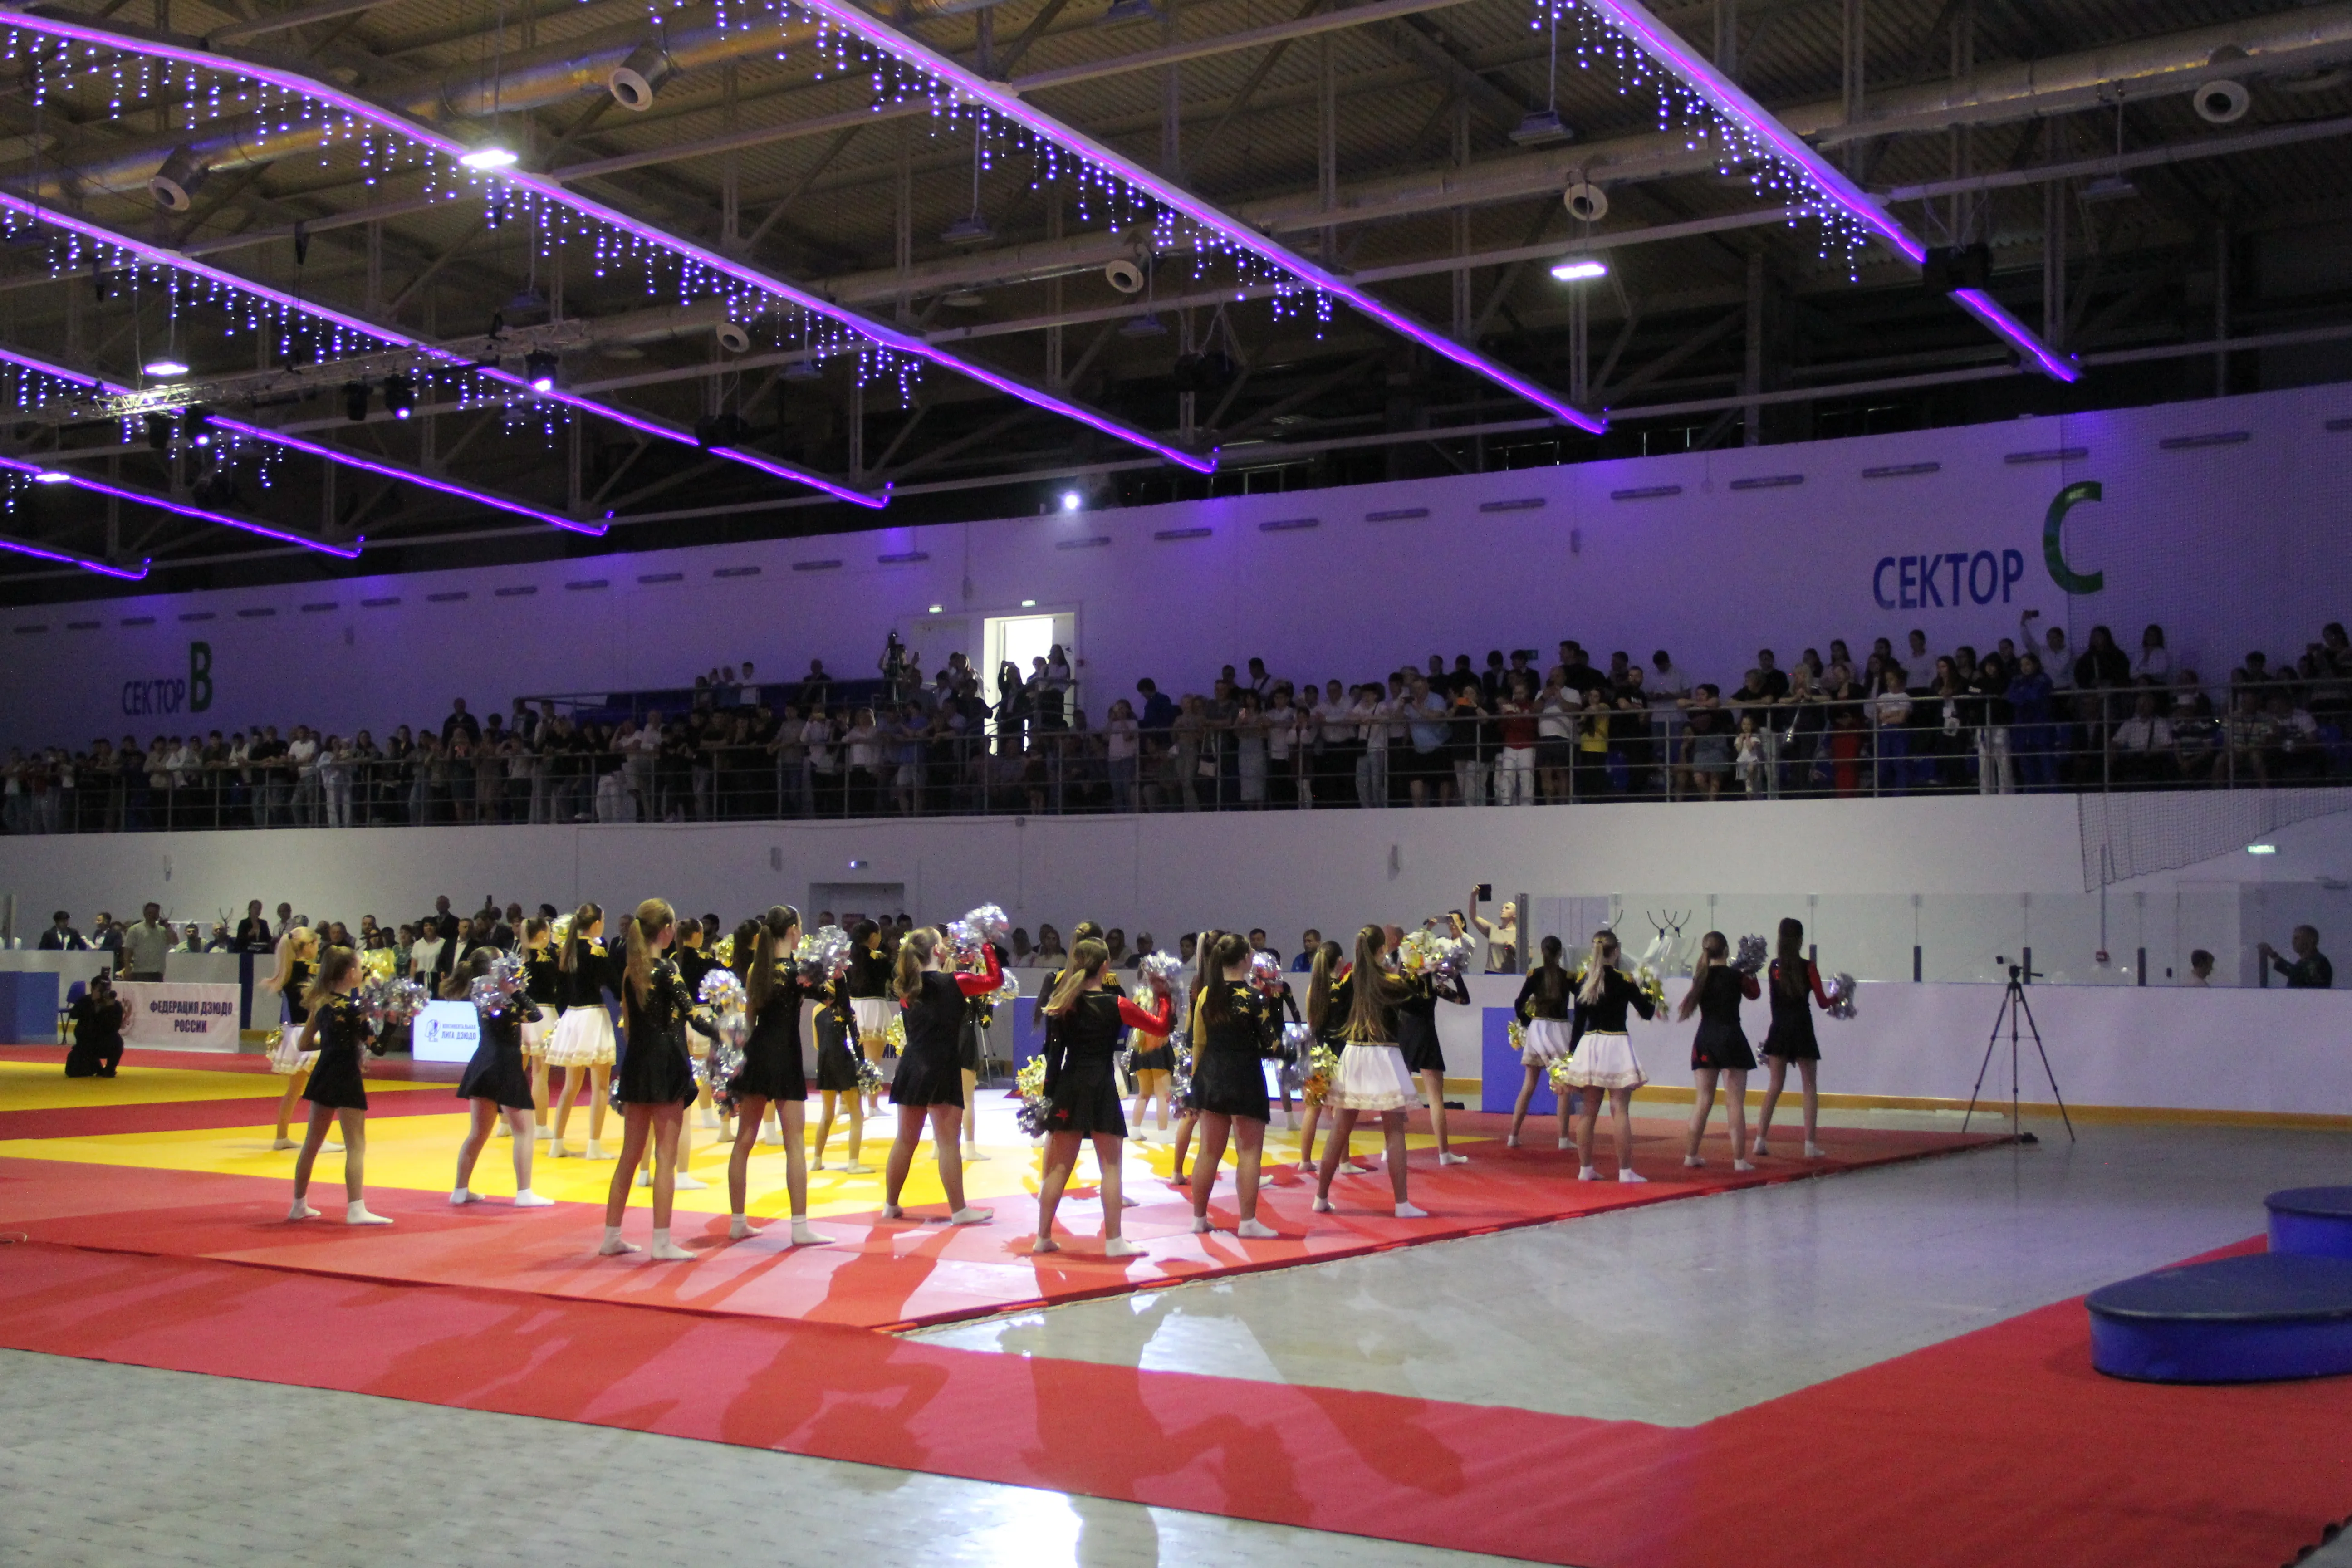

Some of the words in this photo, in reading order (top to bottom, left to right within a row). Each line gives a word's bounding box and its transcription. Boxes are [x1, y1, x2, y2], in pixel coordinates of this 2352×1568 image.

[1873, 549, 2024, 610] СЕКТОР
[122, 679, 186, 715] СЕКТОР
[150, 1000, 199, 1015] ФЕДЕРАЦИЯ
[201, 1001, 233, 1016] ДЗЮДО
[174, 1019, 207, 1032] РОССИИ
[456, 1032, 476, 1040] ДЗЮДО
